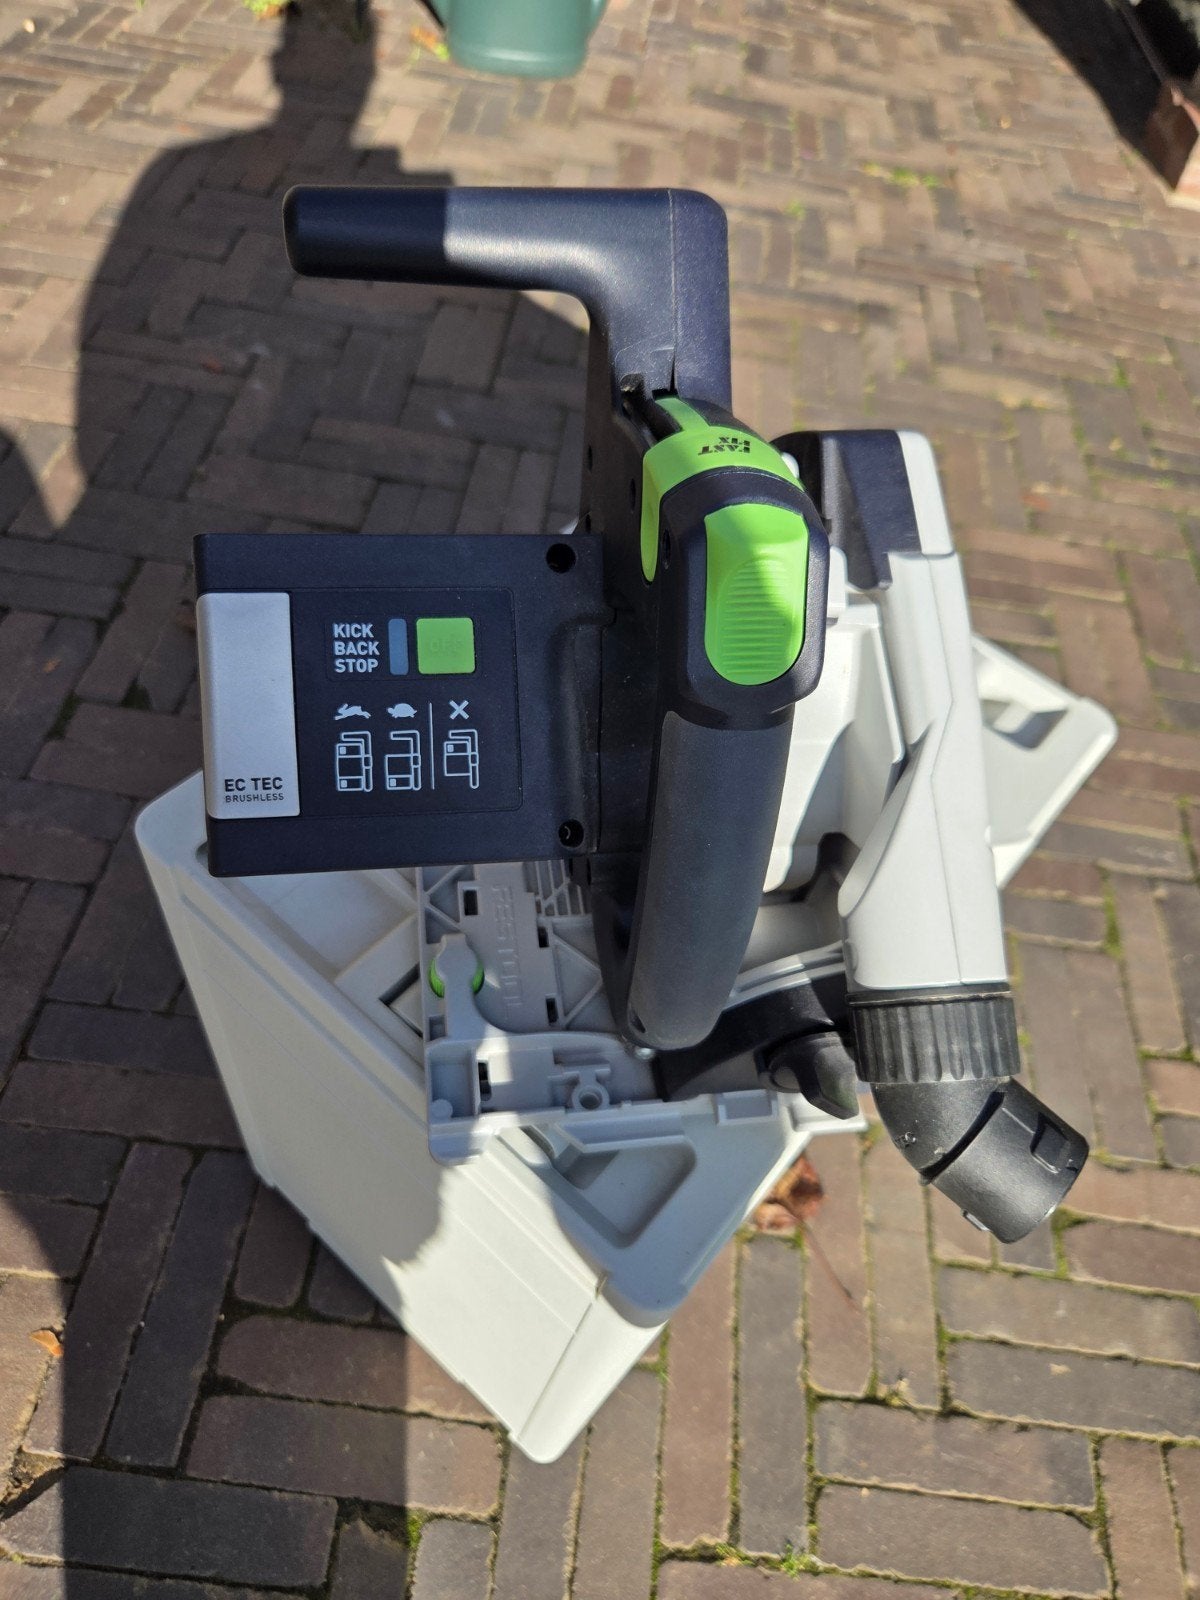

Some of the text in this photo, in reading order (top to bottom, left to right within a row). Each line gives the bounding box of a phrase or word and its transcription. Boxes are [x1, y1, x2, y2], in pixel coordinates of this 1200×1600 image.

[719, 437, 750, 446] FIX
[698, 445, 750, 456] FAST
[333, 622, 374, 638] KICK
[333, 640, 380, 656] BACK
[334, 658, 379, 673] STOP
[224, 776, 283, 792] EC TEC
[225, 793, 285, 803] BRUSHLESS
